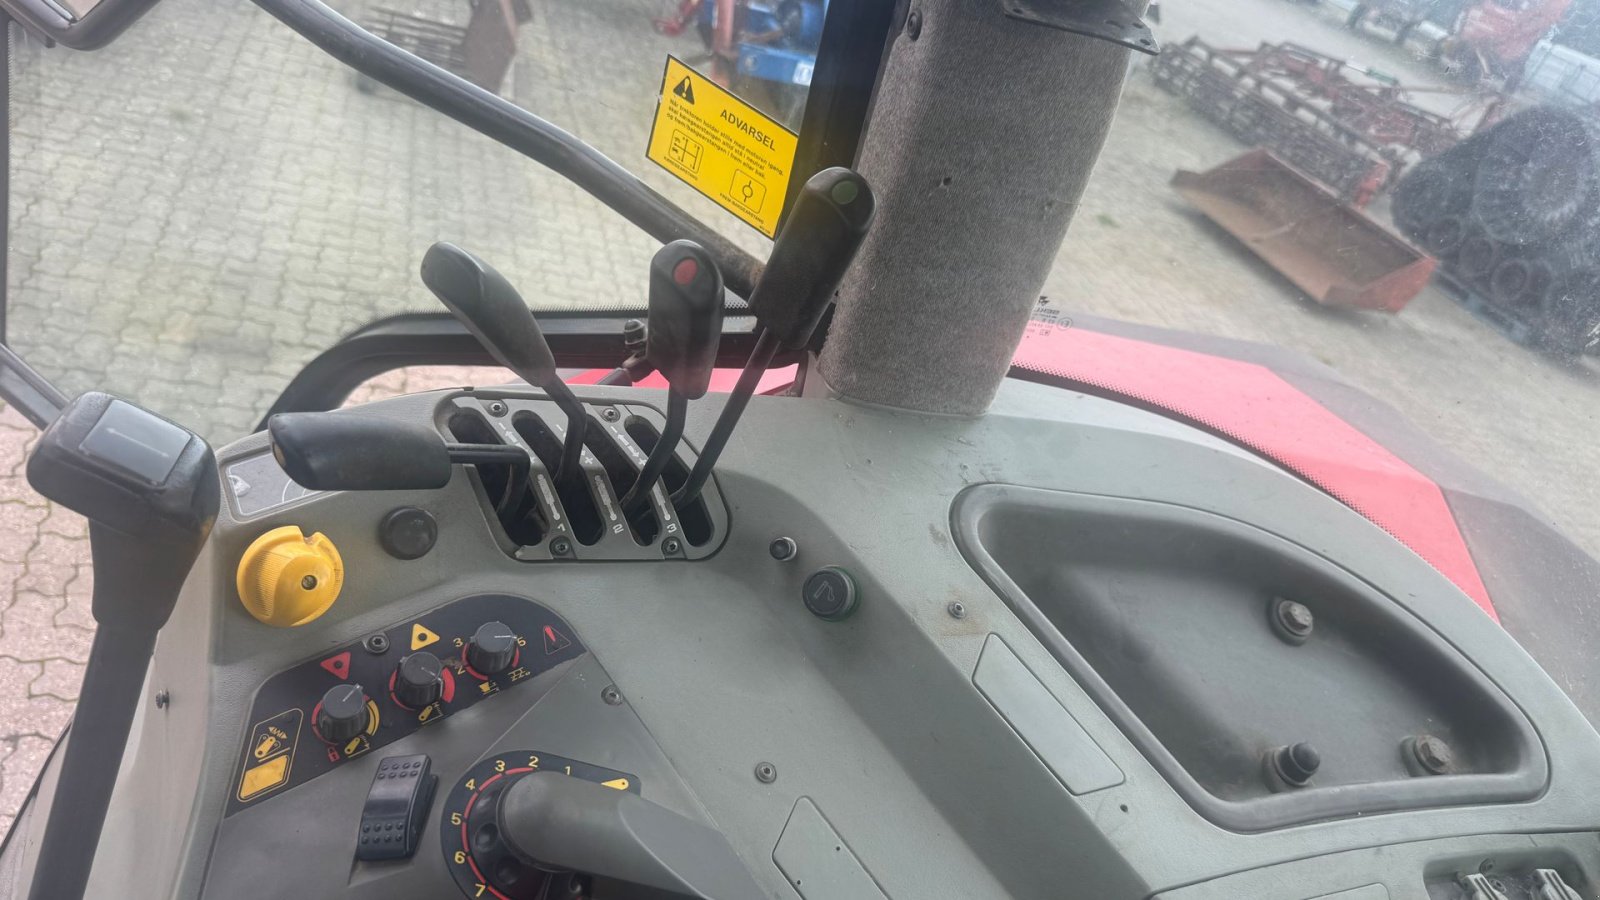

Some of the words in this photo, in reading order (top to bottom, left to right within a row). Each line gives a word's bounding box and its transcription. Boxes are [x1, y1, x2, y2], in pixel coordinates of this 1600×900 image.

[719, 107, 776, 151] ADVARSEL
[612, 523, 624, 534] 2
[666, 523, 677, 533] 3
[453, 637, 464, 648] 3
[495, 760, 506, 772] 3
[528, 756, 539, 768] 2
[565, 766, 572, 776] 1
[465, 778, 476, 791] 4
[451, 812, 462, 826] 5
[454, 851, 466, 864] 6
[475, 883, 486, 898] 7
